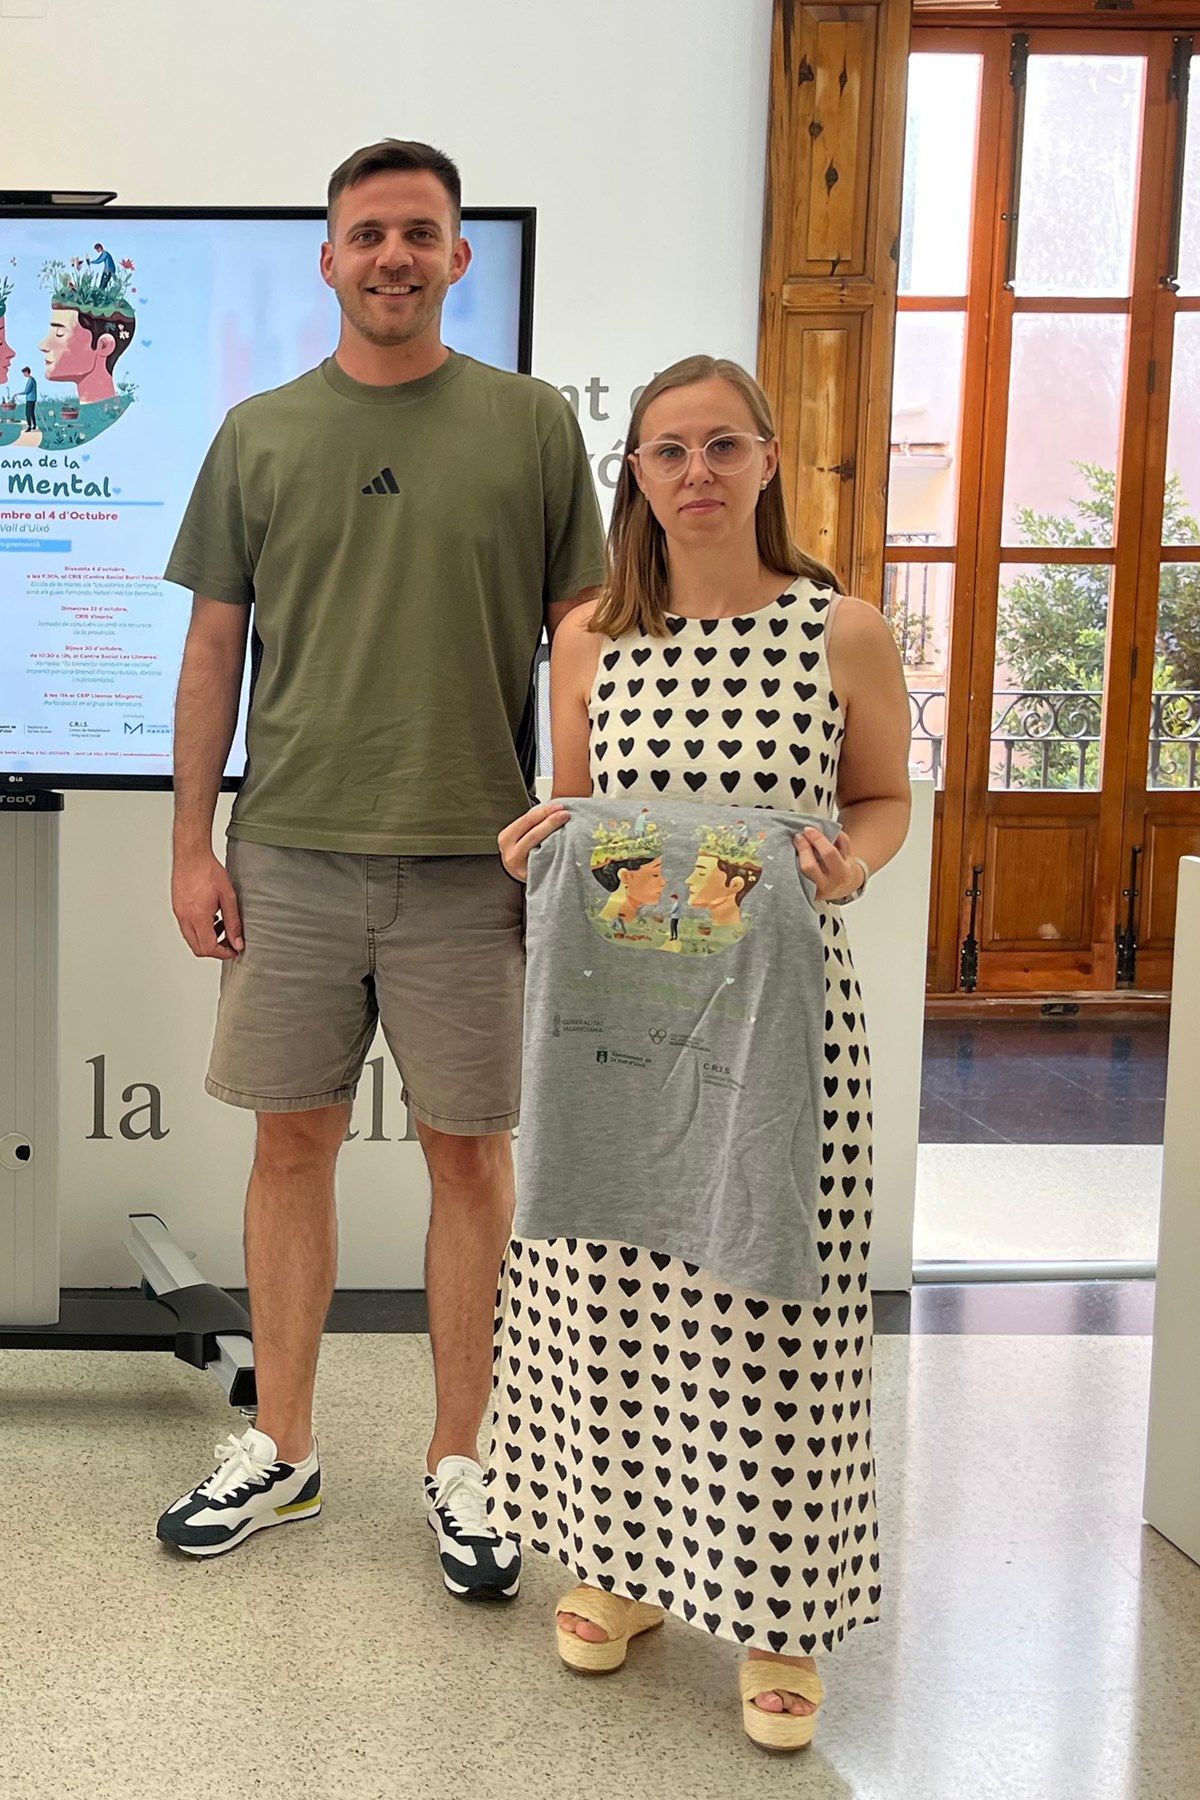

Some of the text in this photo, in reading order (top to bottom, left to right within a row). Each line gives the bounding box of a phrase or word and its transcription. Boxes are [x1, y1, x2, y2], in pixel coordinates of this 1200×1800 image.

[38, 455, 58, 468] de
[64, 455, 81, 469] la
[8, 473, 111, 498] Mental
[35, 510, 46, 520] al
[48, 511, 56, 520] 4
[58, 510, 119, 521] d'Octubre
[1, 524, 18, 533] Vall
[19, 524, 50, 533] d'Uixó
[85, 1054, 170, 1141] la
